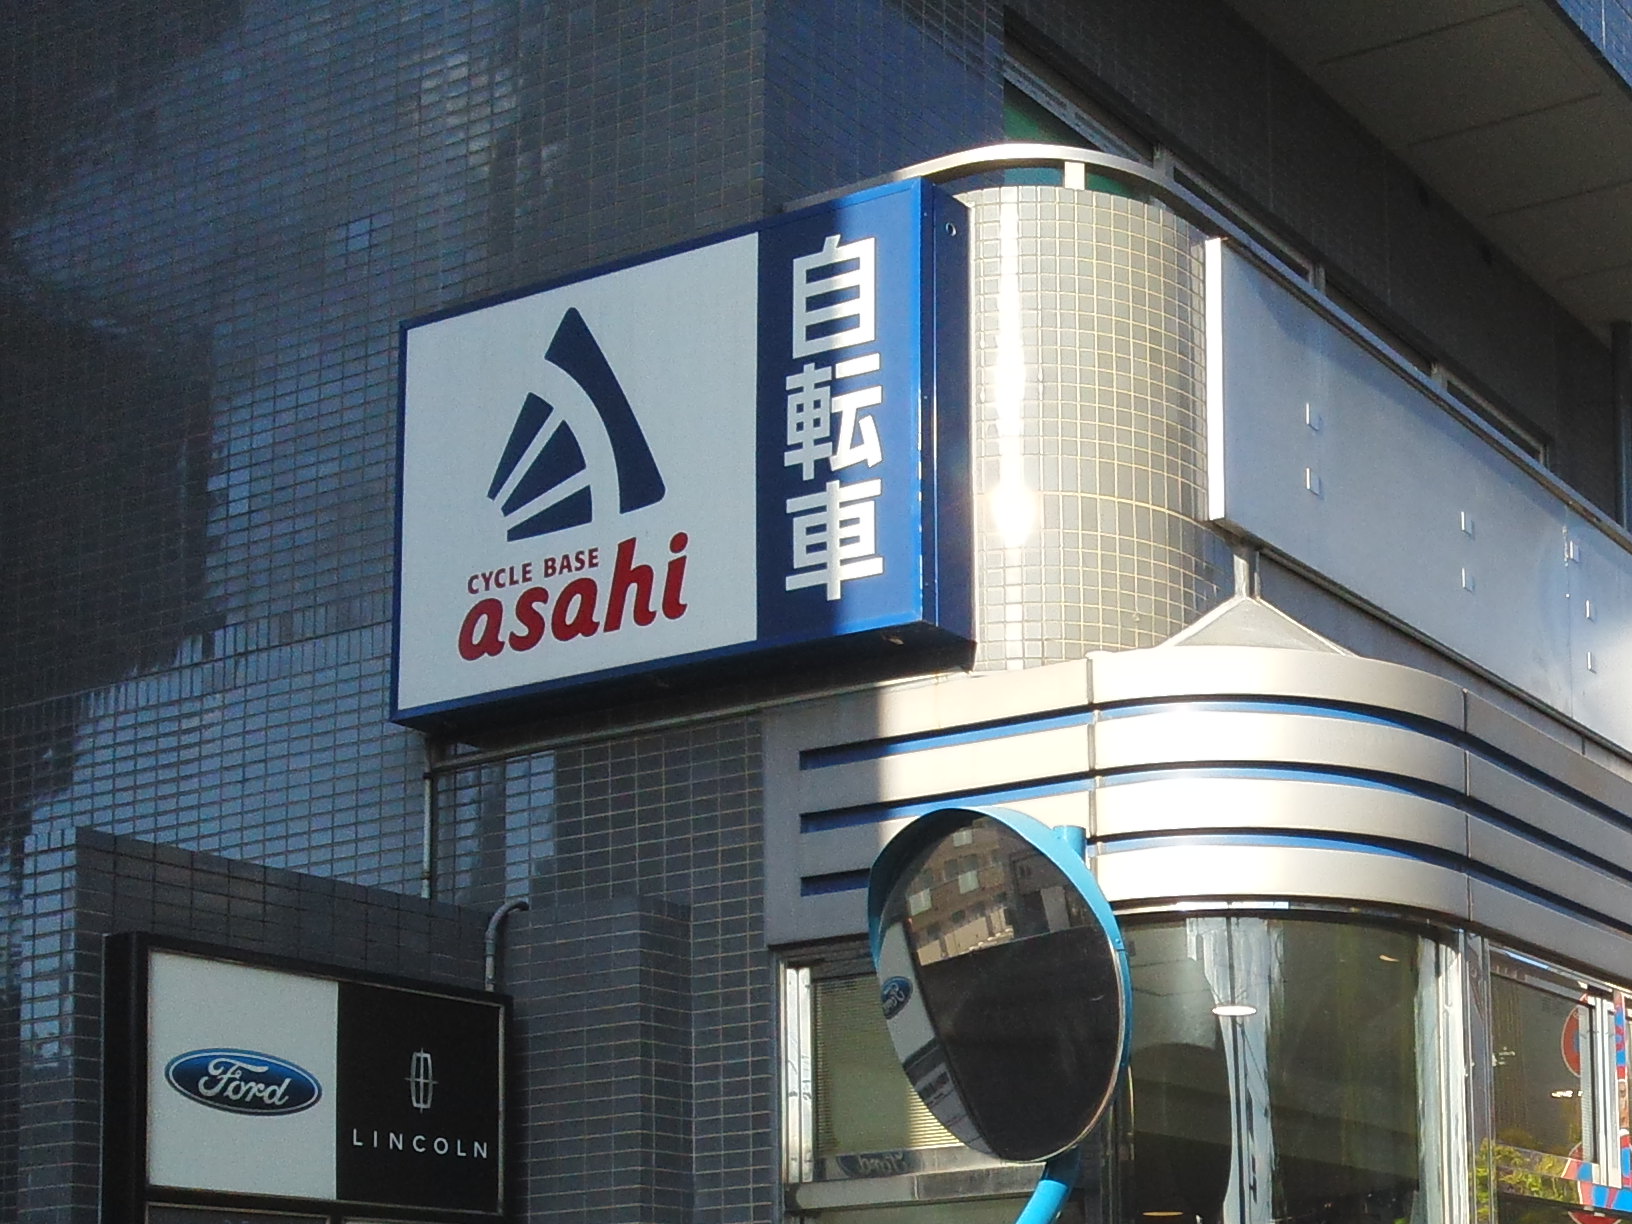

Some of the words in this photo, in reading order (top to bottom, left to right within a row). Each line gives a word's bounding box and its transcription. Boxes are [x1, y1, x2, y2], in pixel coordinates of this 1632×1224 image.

[783, 233, 884, 602] 自転車
[467, 561, 533, 595] CYCLE
[543, 546, 600, 579] BASE
[458, 531, 689, 661] asahi
[198, 1057, 291, 1106] Ford
[352, 1128, 489, 1160] LINCOLN
